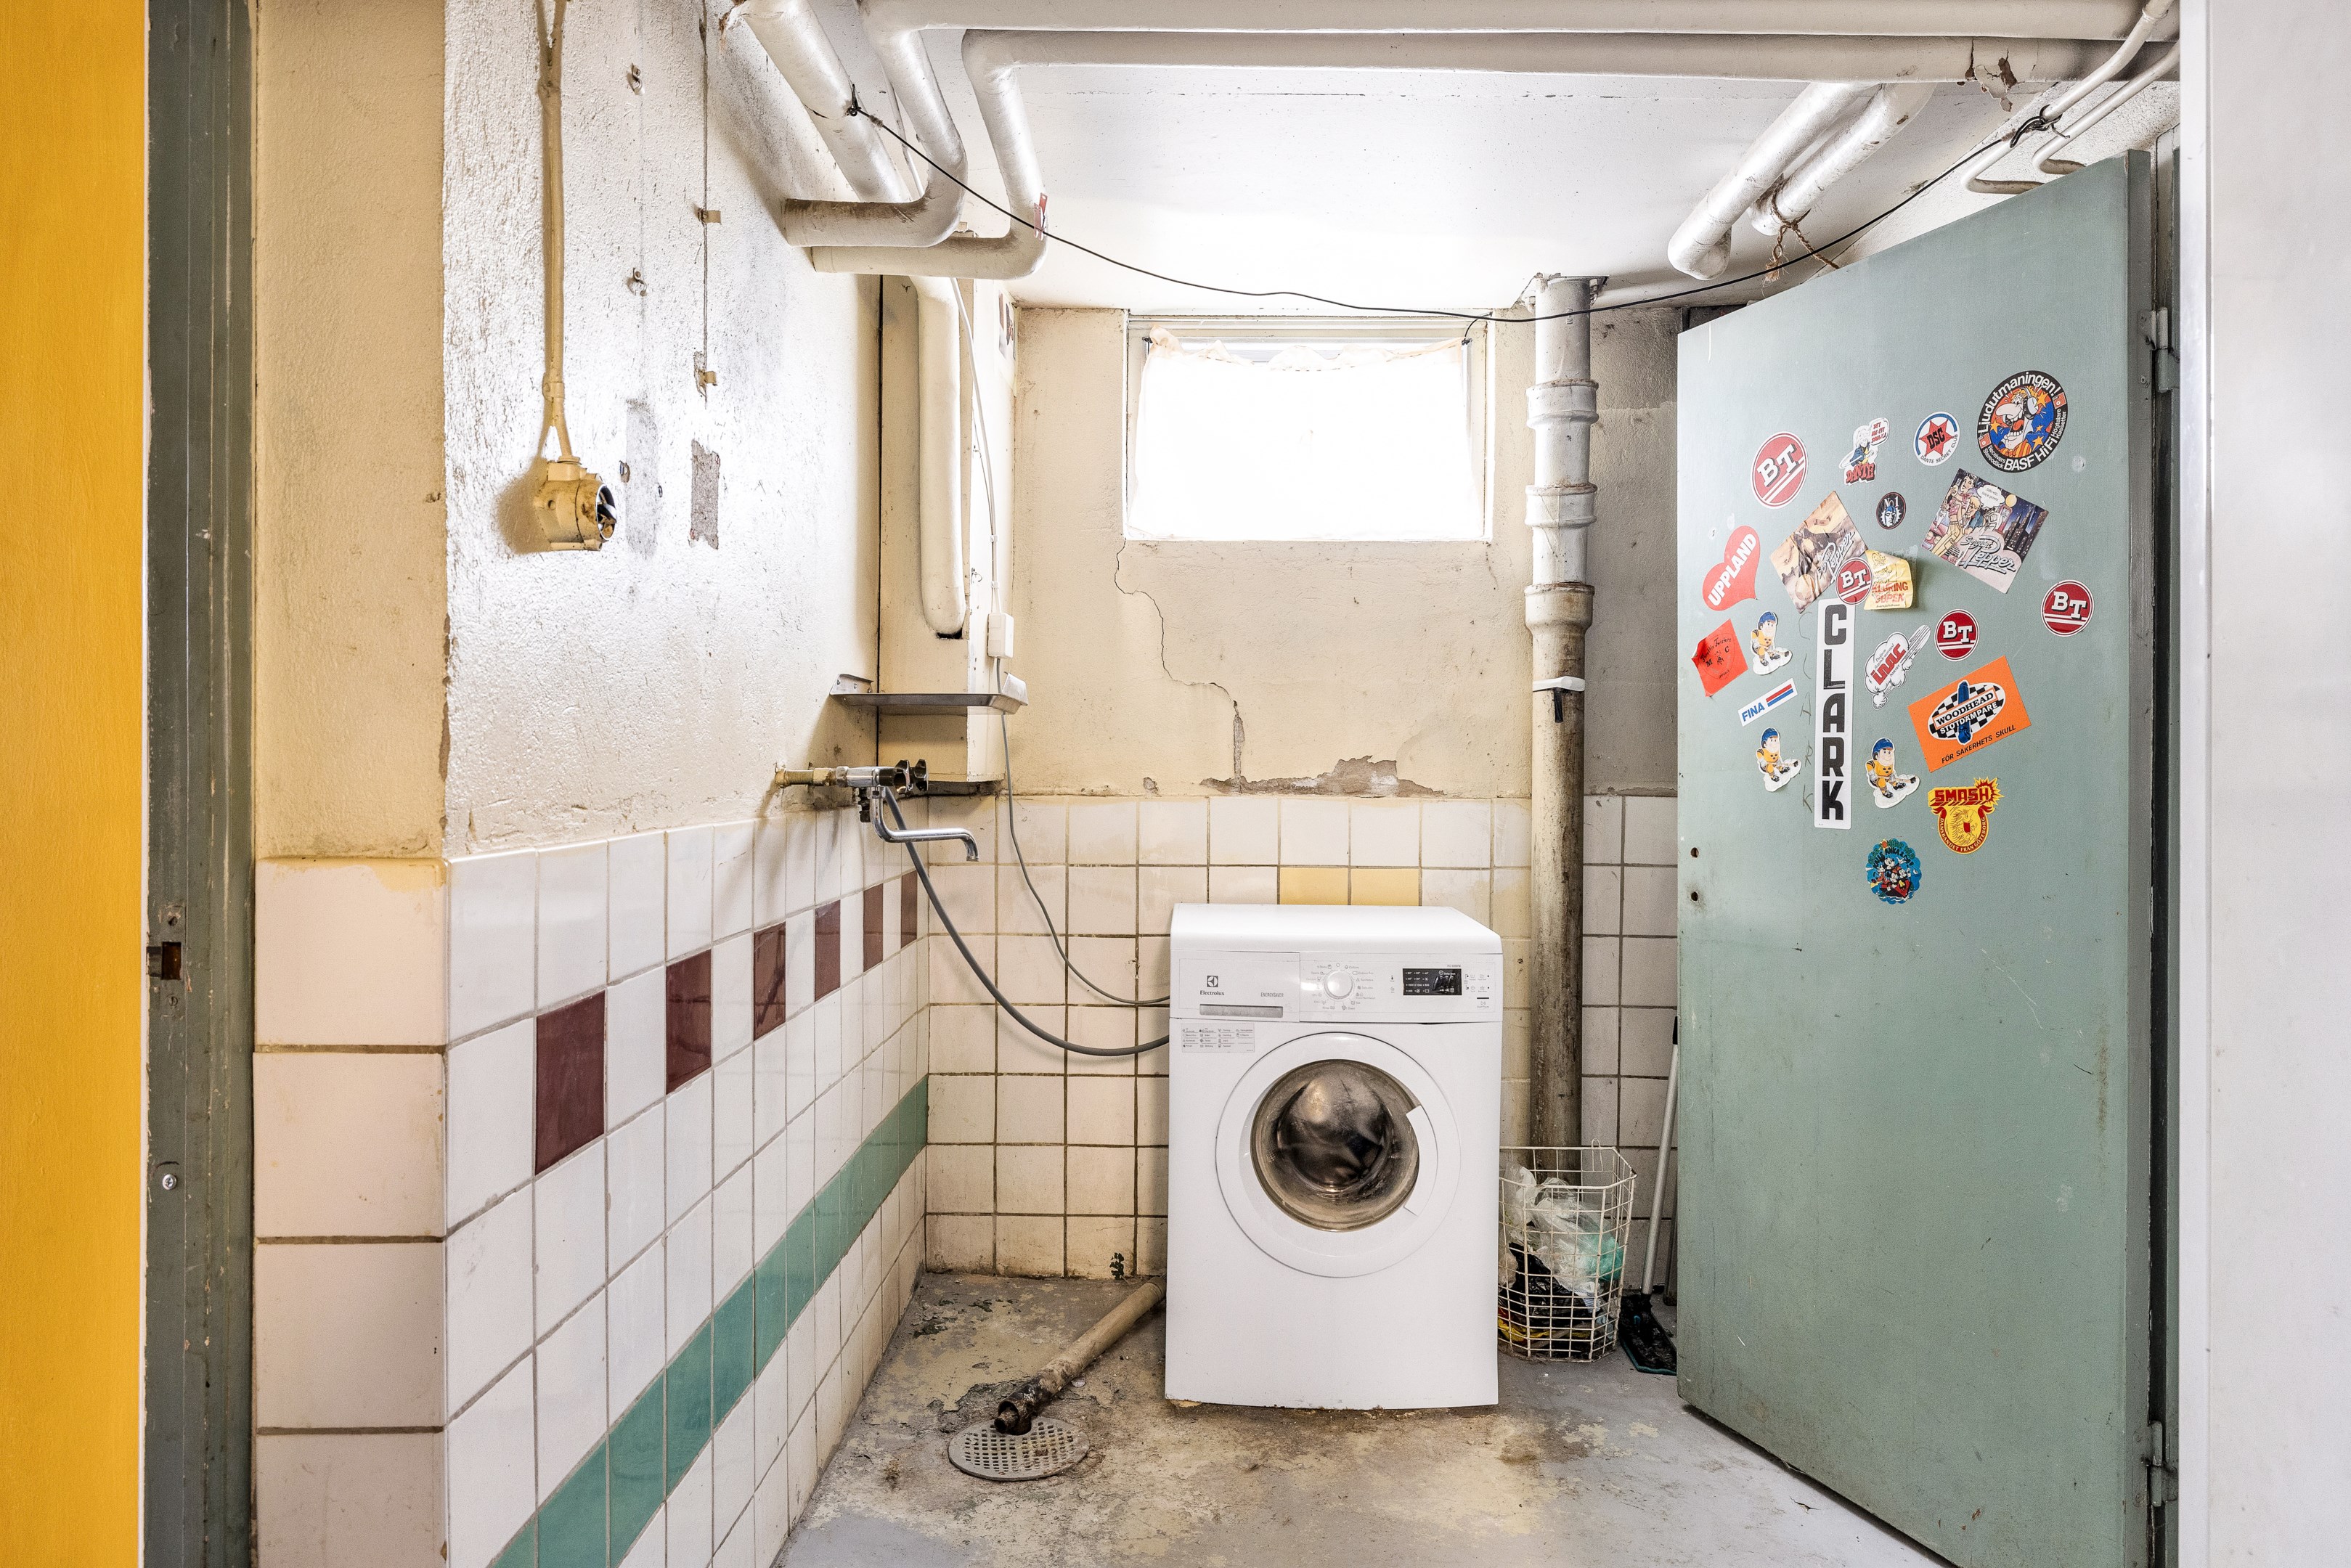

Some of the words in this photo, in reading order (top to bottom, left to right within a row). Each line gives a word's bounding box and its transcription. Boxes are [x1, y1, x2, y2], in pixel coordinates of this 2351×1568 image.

[1978, 372, 2061, 433] Ljudutmaningen!
[2051, 409, 2061, 437] Högtalare
[2055, 411, 2066, 438] Kassetter
[1927, 427, 1945, 449] DSC
[1757, 444, 1797, 487] BT
[1920, 455, 1934, 464] DANTE
[1936, 449, 1952, 463] SECRET
[1987, 444, 2006, 463] Receivers
[2004, 454, 2034, 471] BASF
[1846, 462, 1875, 483] DANTE
[1963, 534, 2016, 571] Pepper
[1708, 534, 1756, 606] UPPLAND
[1841, 568, 1867, 589] BT
[2051, 591, 2087, 619] BT
[1714, 637, 1732, 647] Twisters
[1943, 621, 1973, 643] BT
[1742, 702, 1765, 722] FINA
[1821, 604, 1847, 820] CLARK
[1936, 693, 1994, 725] WOODHEAD
[1941, 754, 1954, 764] FÖR
[1956, 735, 1993, 756] SÄKERHETS
[1995, 724, 2016, 738] SKULL
[1932, 788, 1989, 804] SMASH
[1939, 818, 1959, 850] DANSBANDET
[1974, 817, 1987, 846] GÖTEBORG
